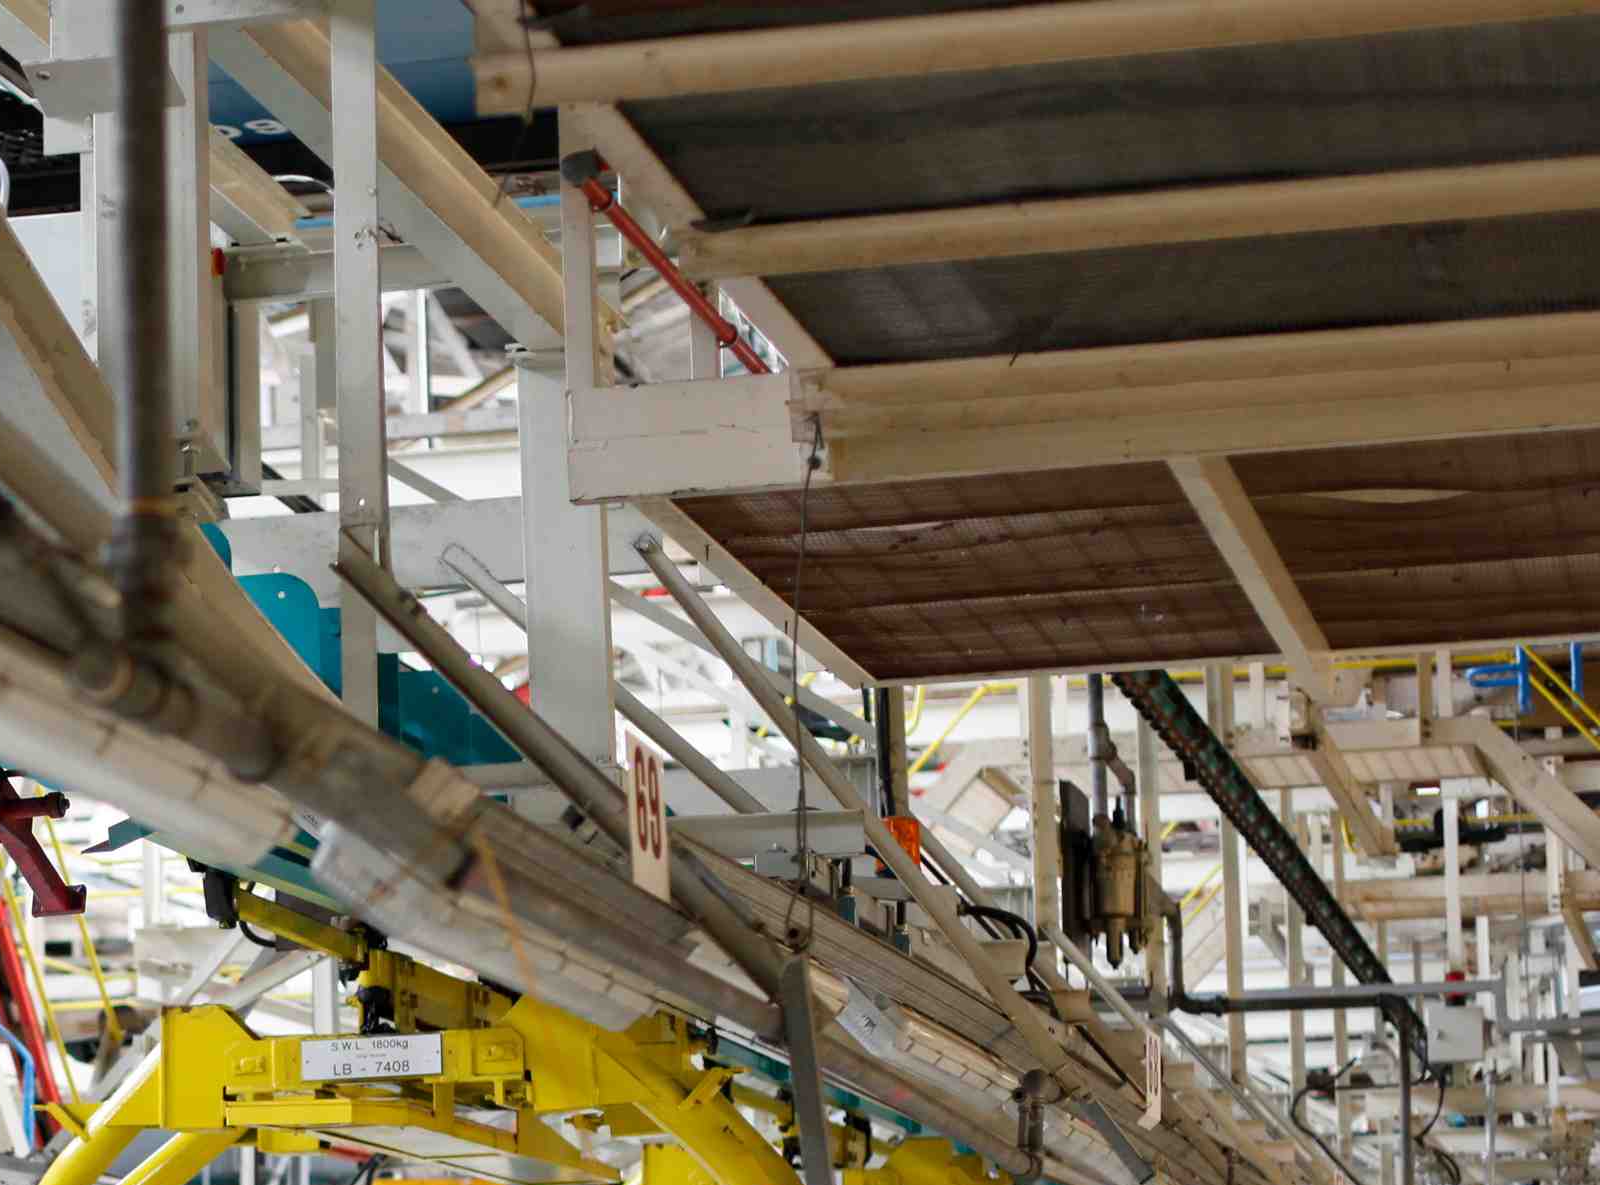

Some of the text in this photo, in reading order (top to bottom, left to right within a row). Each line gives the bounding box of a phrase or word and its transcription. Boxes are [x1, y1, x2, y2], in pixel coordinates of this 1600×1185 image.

[635, 747, 661, 860] 69
[372, 1039, 409, 1050] 1800kg
[333, 1063, 353, 1076] LB
[375, 1060, 410, 1073] 7408
